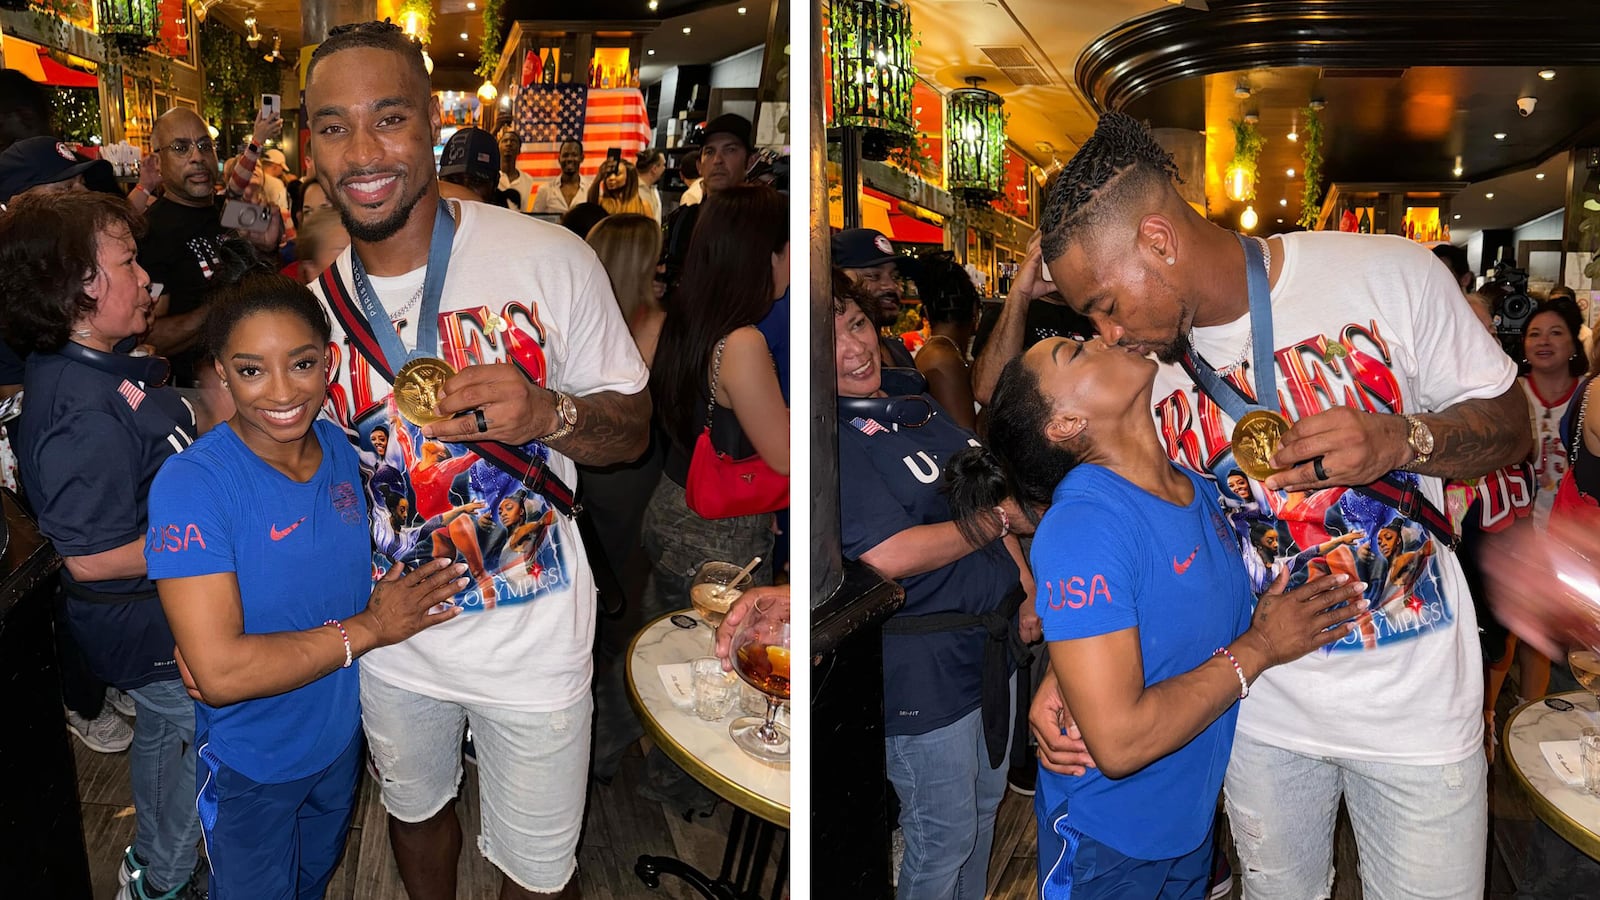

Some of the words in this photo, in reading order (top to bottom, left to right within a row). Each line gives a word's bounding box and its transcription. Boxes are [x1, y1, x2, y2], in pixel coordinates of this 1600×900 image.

[360, 287, 377, 317] PARIS
[151, 523, 207, 552] USA
[463, 567, 559, 607] OLYMPICS
[1045, 574, 1113, 611] USA
[1342, 601, 1441, 645] OLYMPICS
